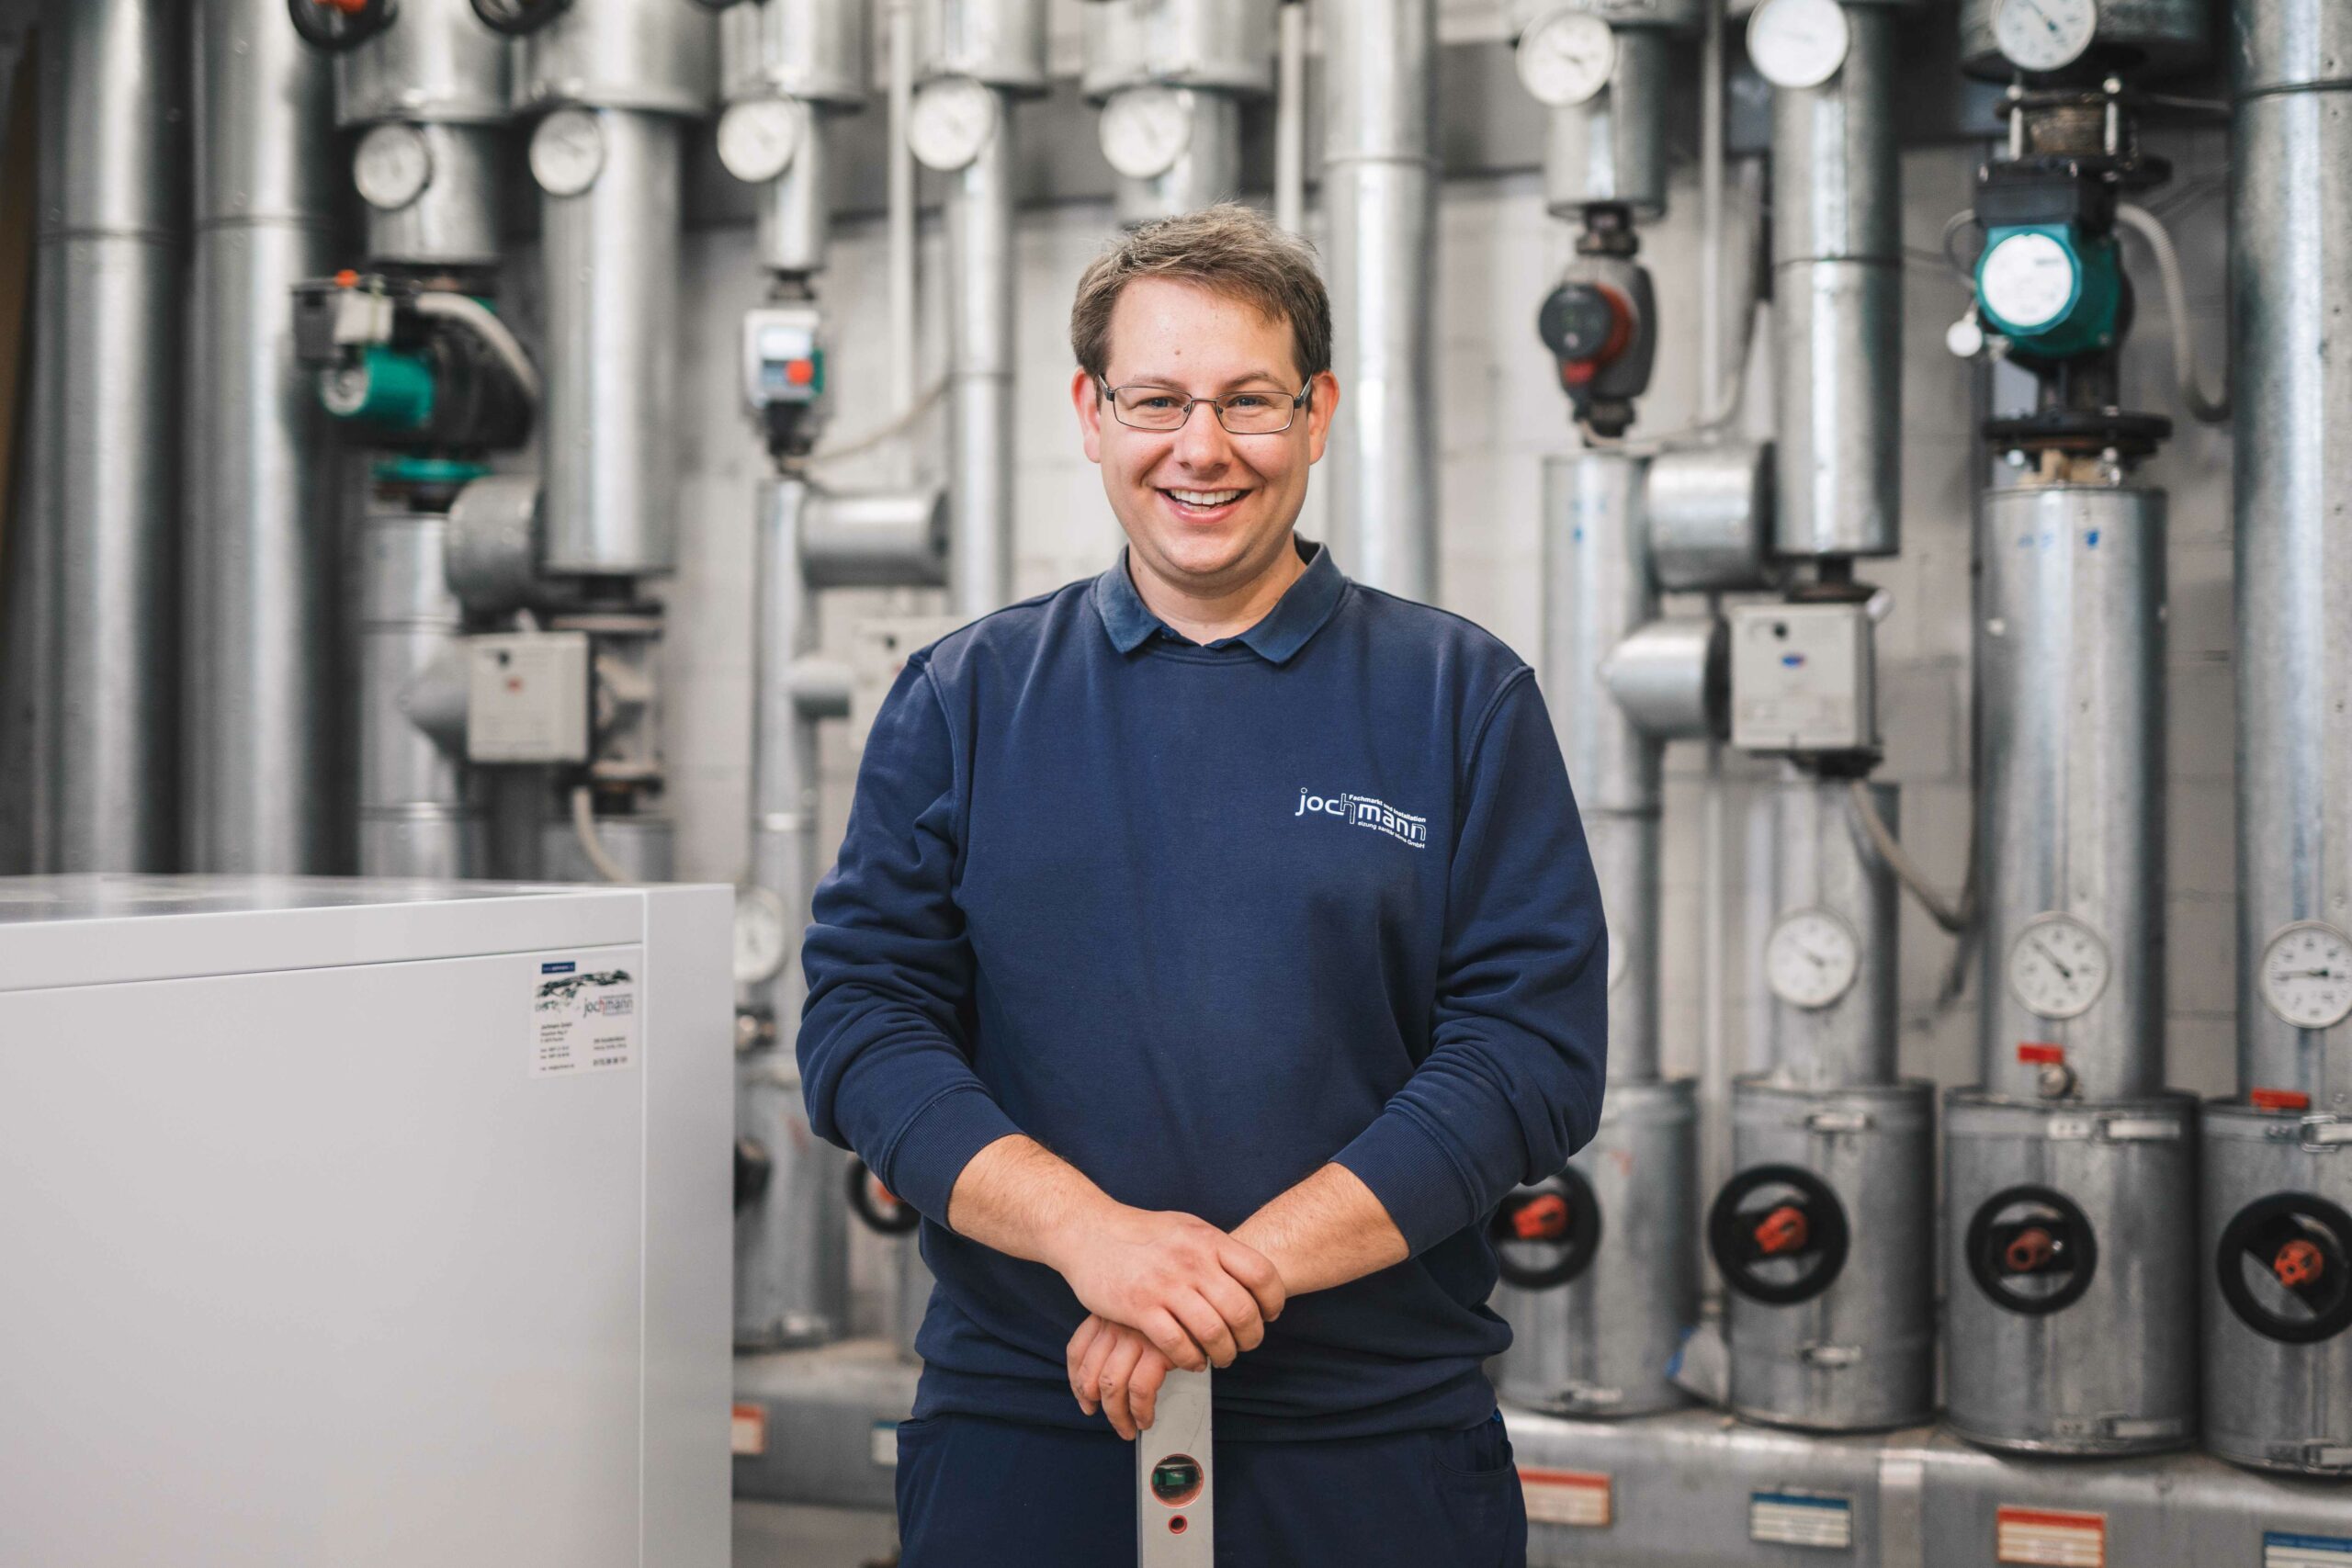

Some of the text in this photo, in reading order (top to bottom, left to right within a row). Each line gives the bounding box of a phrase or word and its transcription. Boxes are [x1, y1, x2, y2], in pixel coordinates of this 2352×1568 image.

[1349, 795, 1384, 806] Fachmarkt
[1383, 803, 1393, 812] und
[1295, 787, 1427, 840] jochmann
[1407, 839, 1425, 849] GmbH
